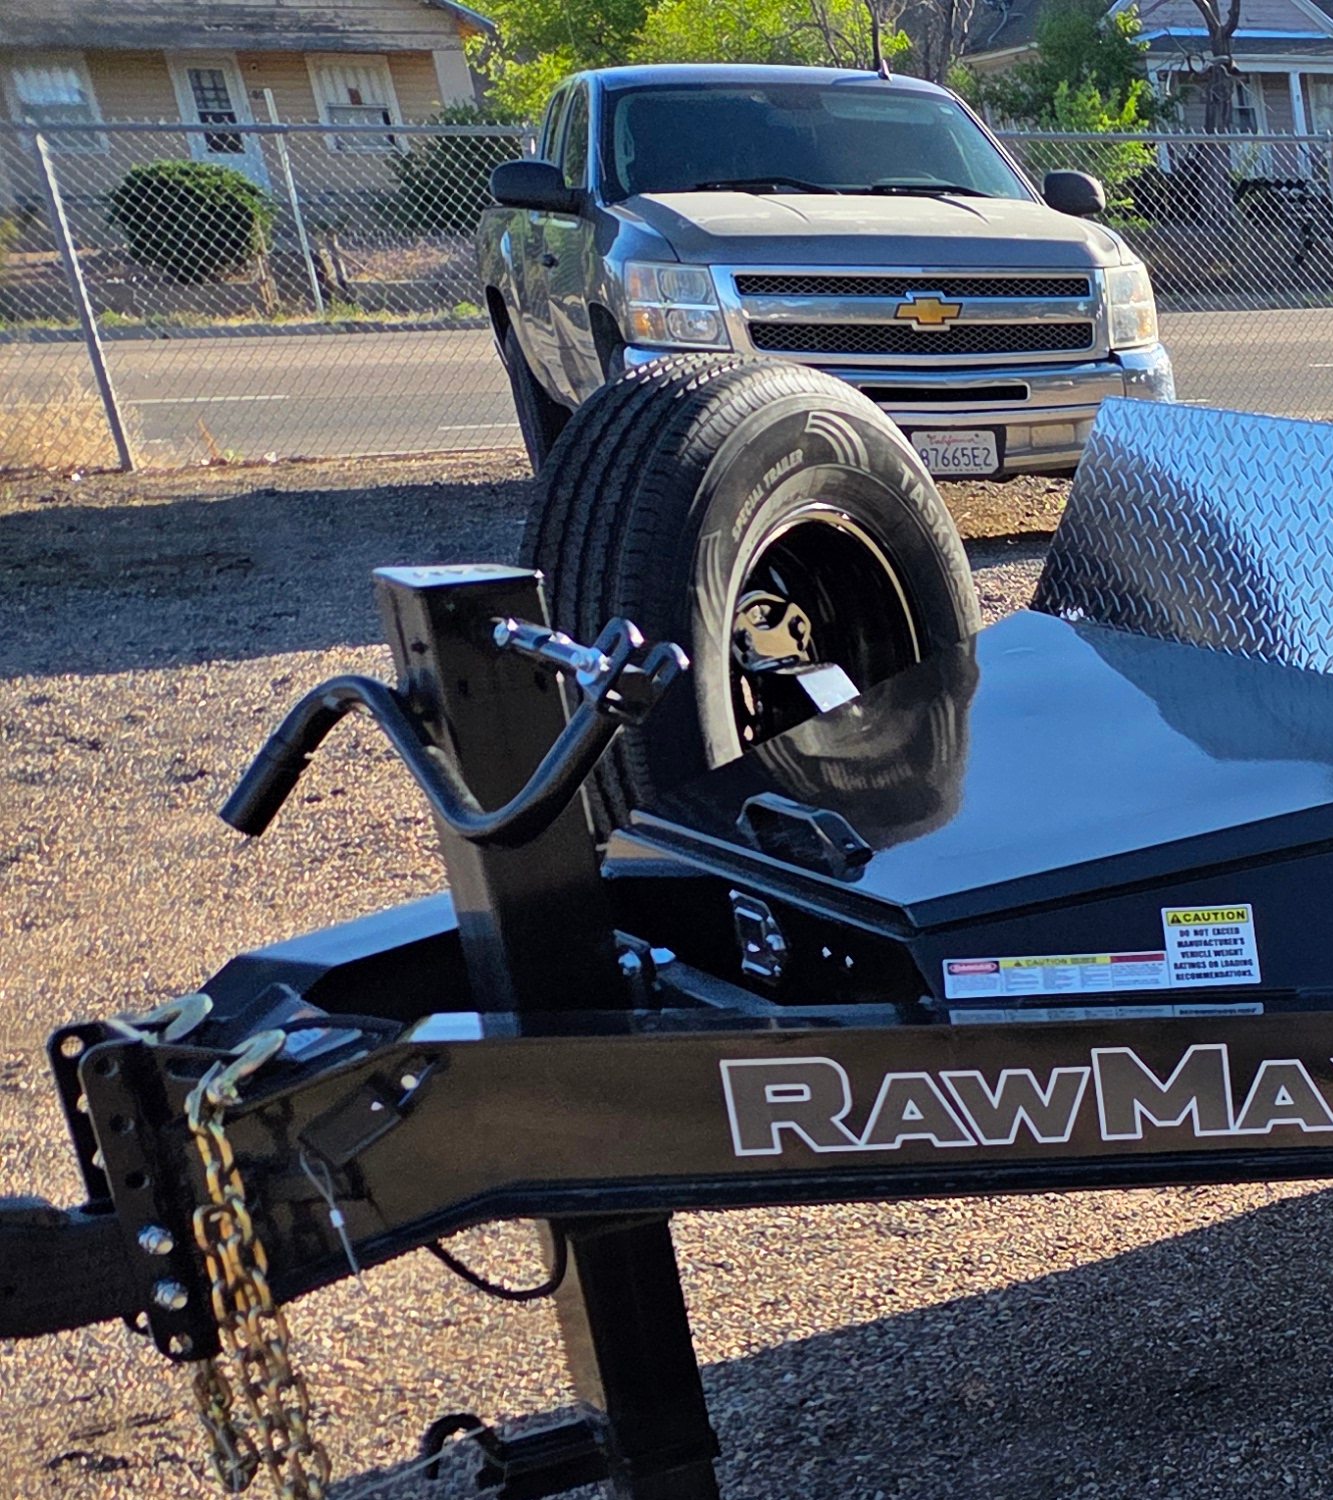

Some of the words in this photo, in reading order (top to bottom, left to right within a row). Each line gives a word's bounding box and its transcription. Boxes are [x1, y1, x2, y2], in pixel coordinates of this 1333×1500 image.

[921, 447, 992, 468] 87665E2
[763, 448, 804, 490] TRAILER
[1182, 910, 1246, 922] CAUTION
[1179, 929, 1190, 937] DO
[1193, 928, 1208, 937] NOT
[1212, 927, 1240, 935] EXCEED
[1177, 937, 1245, 948] MANUFACTURER'S
[1181, 949, 1212, 958] VEHICLE
[1213, 948, 1243, 957] WEIGHT
[1174, 961, 1206, 970] RATINGS
[1208, 960, 1219, 968] OR
[1221, 959, 1253, 968] LOADING
